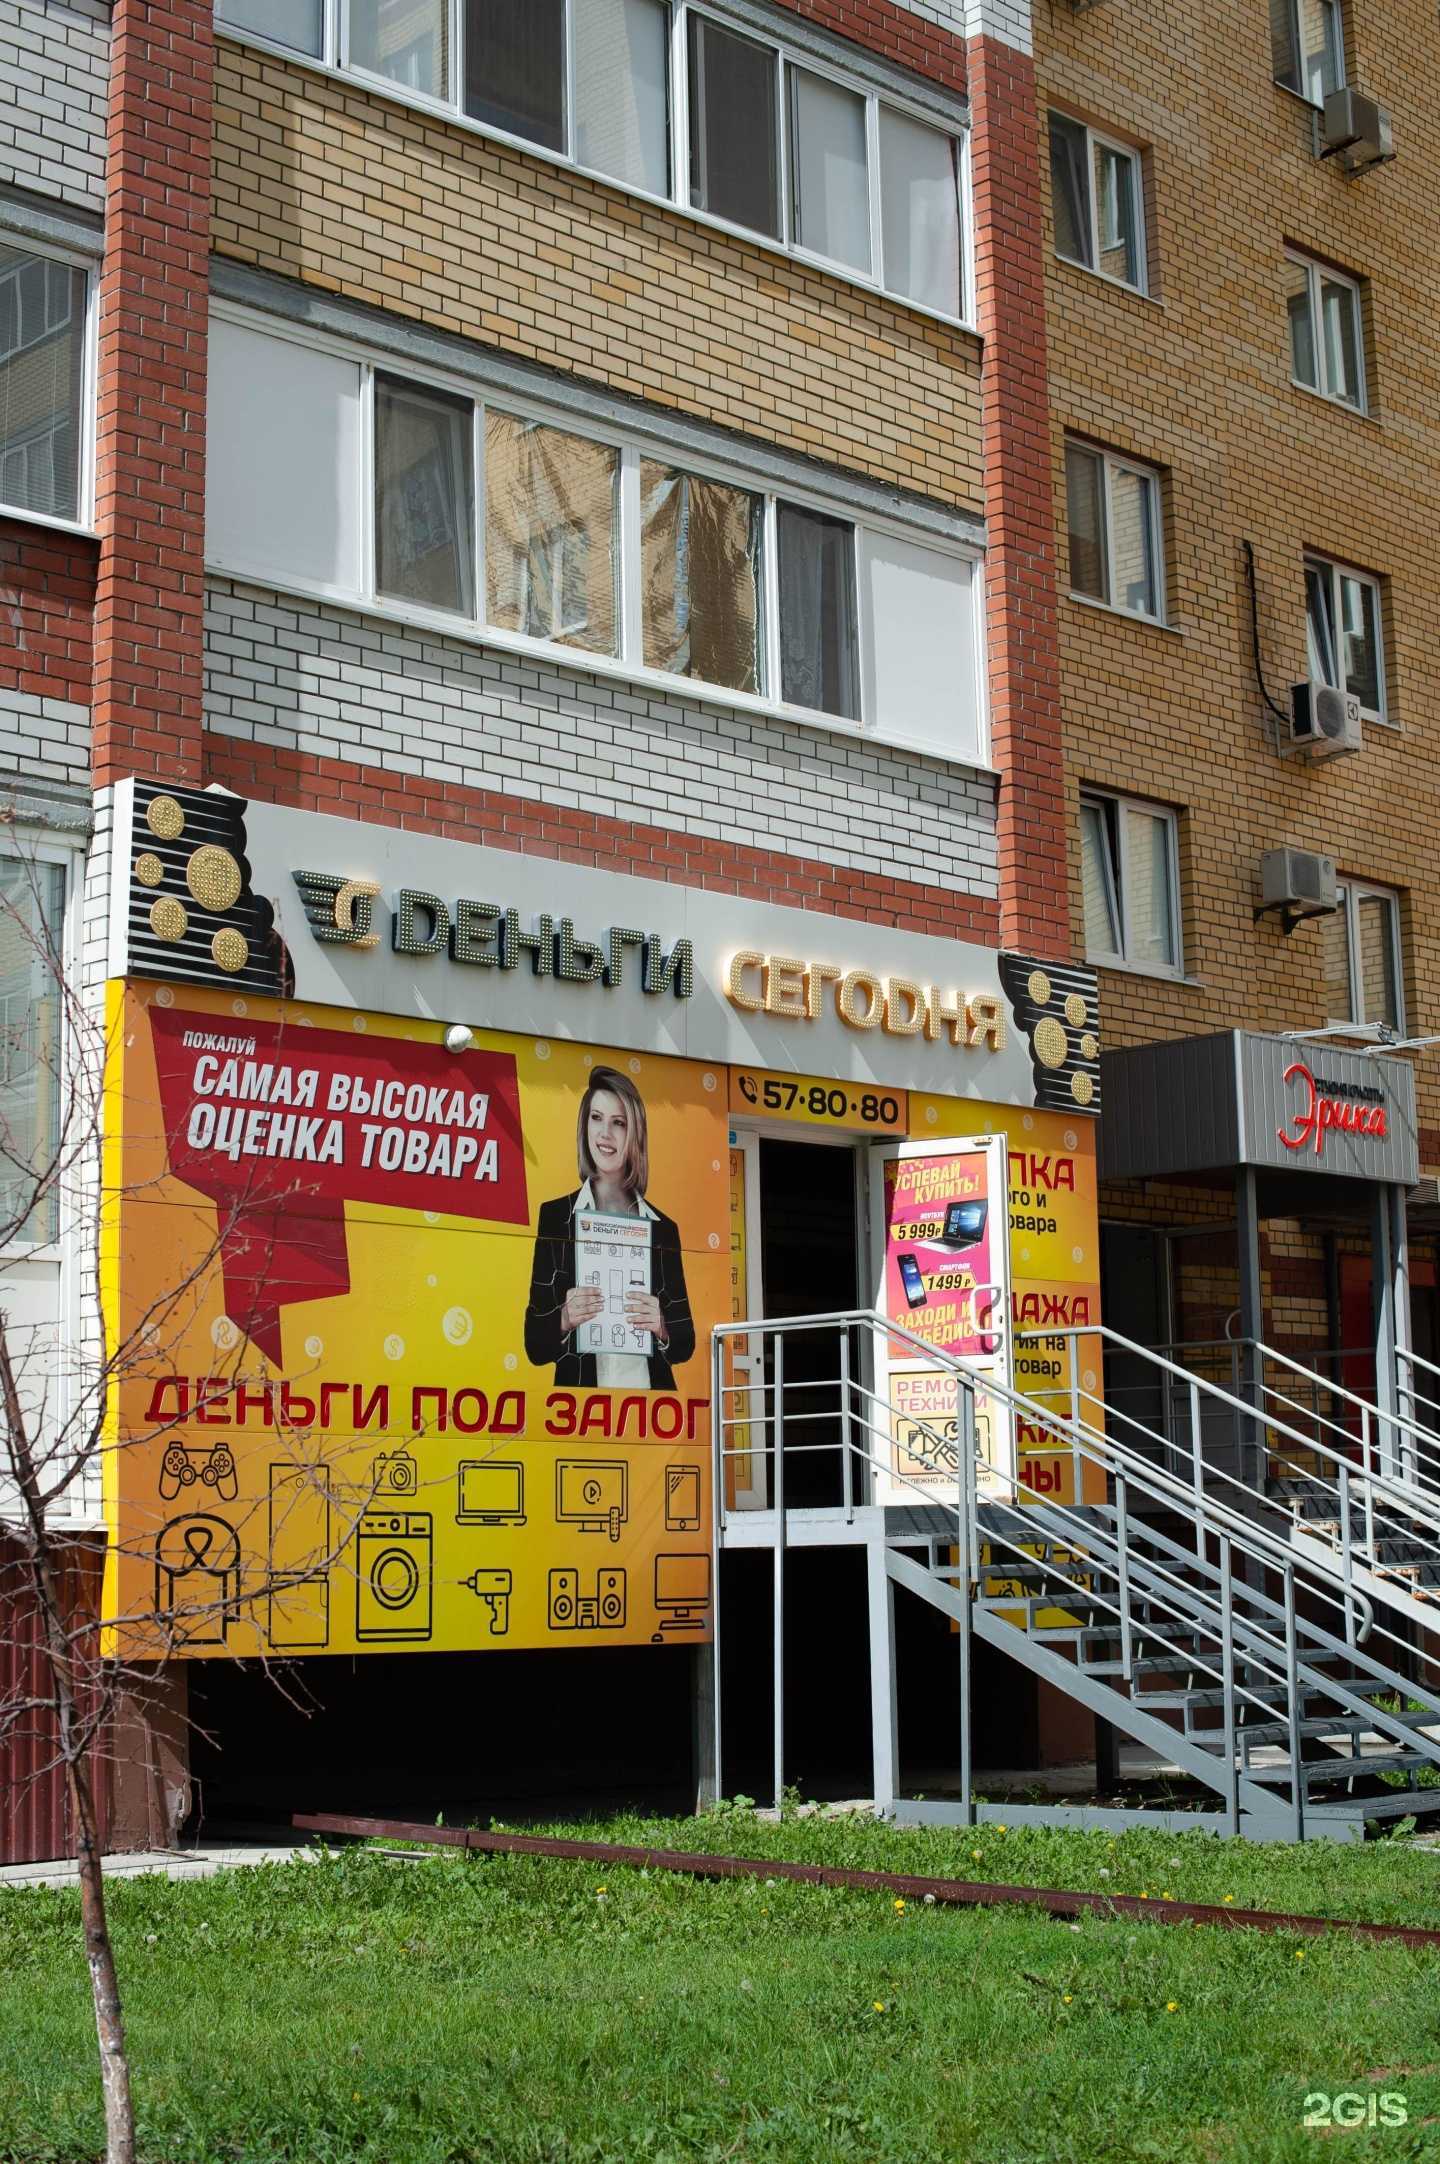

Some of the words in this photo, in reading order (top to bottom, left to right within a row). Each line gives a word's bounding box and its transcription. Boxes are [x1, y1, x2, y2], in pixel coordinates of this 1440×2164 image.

[183, 1030, 257, 1056] ПОЖАЛУЙ
[193, 1055, 319, 1108] САМАЯ
[326, 1072, 490, 1130] ВЫСОКАЯ
[1278, 1063, 1387, 1153] Эрика
[187, 1102, 345, 1164] ОЦЕНКА
[360, 1123, 499, 1182] ТОВАРА
[895, 1160, 961, 1192] УСПЕВАЙ
[914, 1174, 980, 1204] КУПИТЬ!
[1036, 1193, 1047, 1208] и
[896, 1303, 957, 1330] ЗАХОДИ
[144, 1375, 389, 1430] ДЕНЬГИ
[412, 1386, 526, 1434] ПОД
[545, 1392, 710, 1440] ЗАЛОГ
[897, 1394, 987, 1412] ТЕХНИИ
